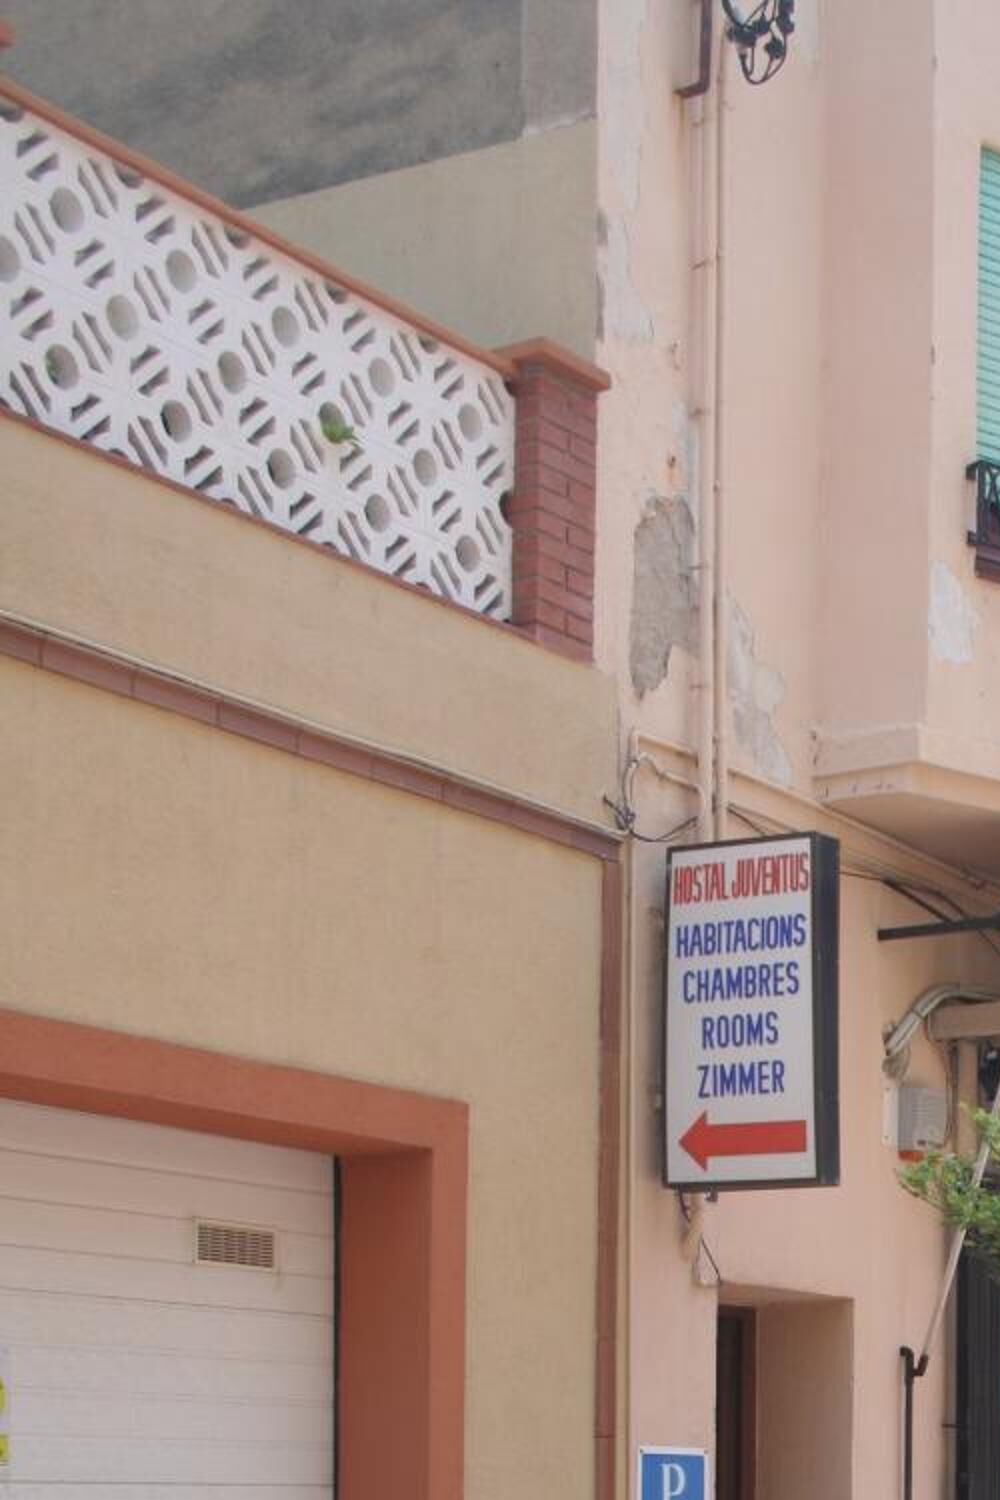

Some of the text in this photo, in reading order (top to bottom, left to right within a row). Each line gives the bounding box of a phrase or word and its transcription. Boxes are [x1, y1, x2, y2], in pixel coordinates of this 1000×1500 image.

[673, 852, 809, 905] HOSTAL JUVENTUS
[676, 913, 806, 959] HABITACIONS
[682, 961, 800, 1004] CHAMBRES
[702, 1011, 779, 1051] ROOMS
[697, 1060, 785, 1099] ZIMMER
